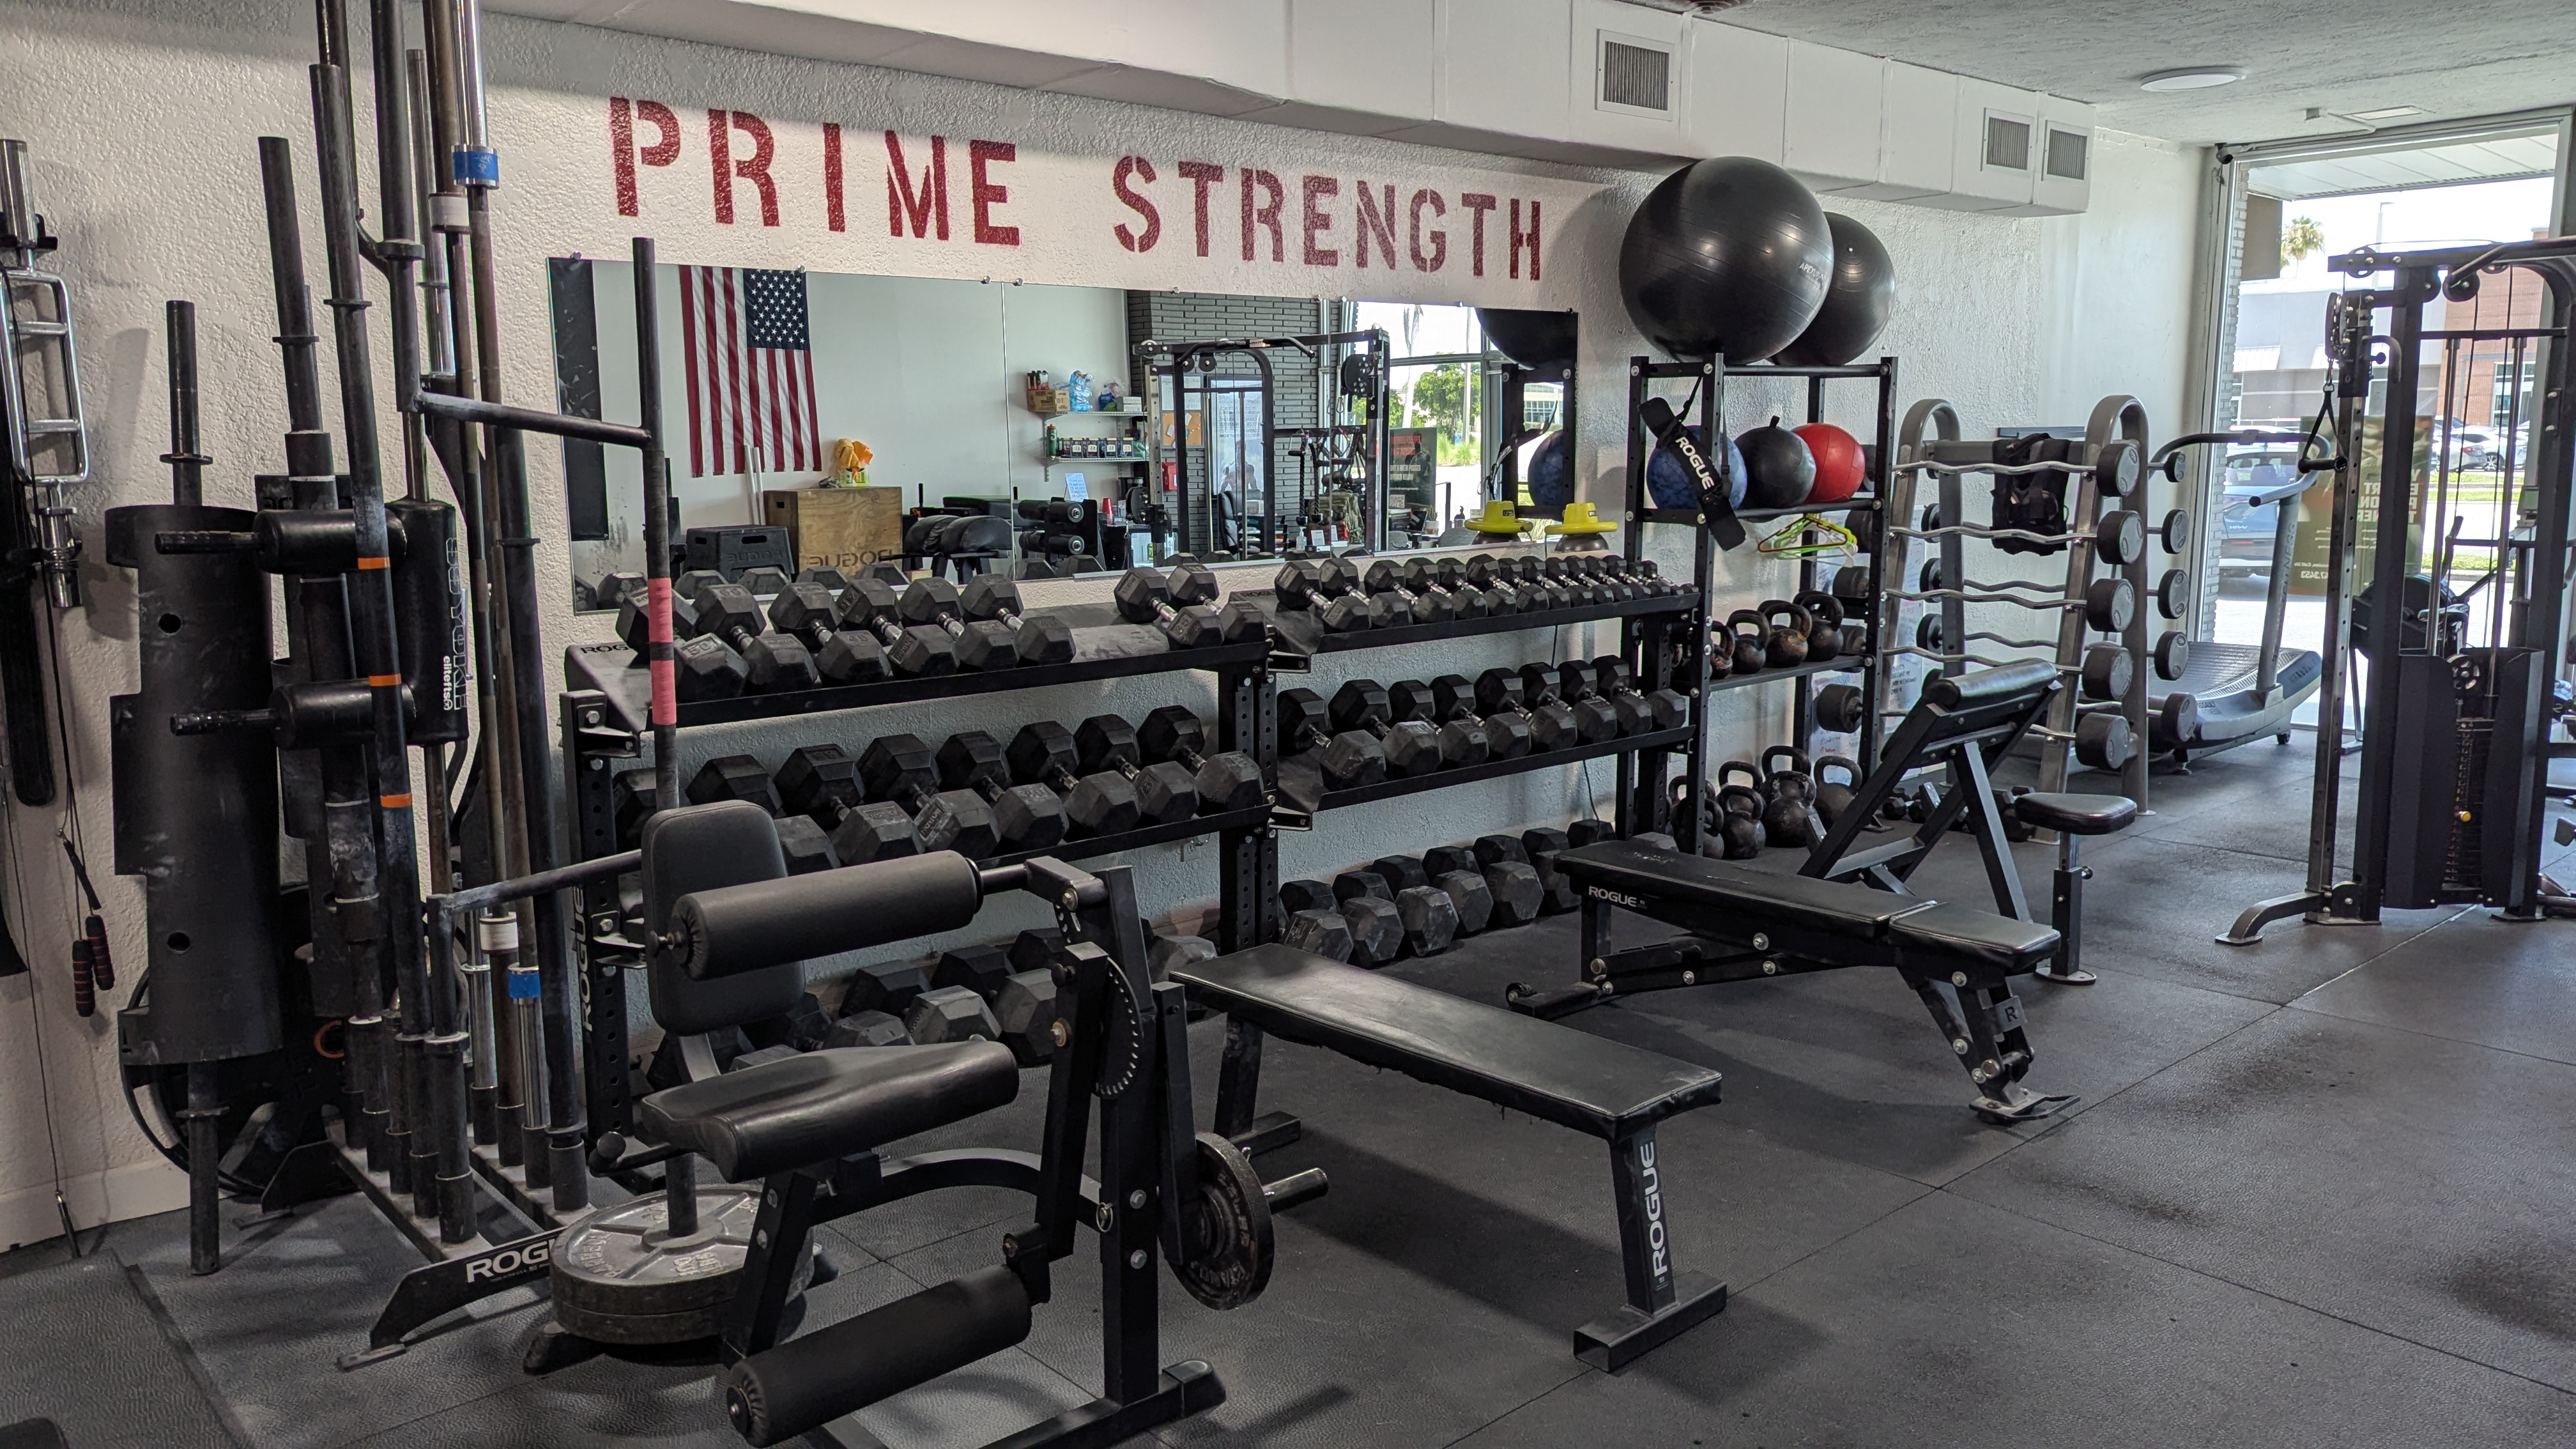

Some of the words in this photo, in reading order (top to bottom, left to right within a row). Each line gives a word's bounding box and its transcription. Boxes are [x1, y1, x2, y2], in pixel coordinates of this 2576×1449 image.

[609, 96, 1022, 247] PRIME
[1112, 155, 1542, 281] STRENGTH
[1675, 436, 1715, 490] ROGUE
[443, 656, 451, 700] elitefts
[1588, 884, 1637, 908] ROGUE
[572, 885, 593, 1032] ROGUE
[2004, 1006, 2018, 1023] R
[1639, 1140, 1668, 1277] ROGUE
